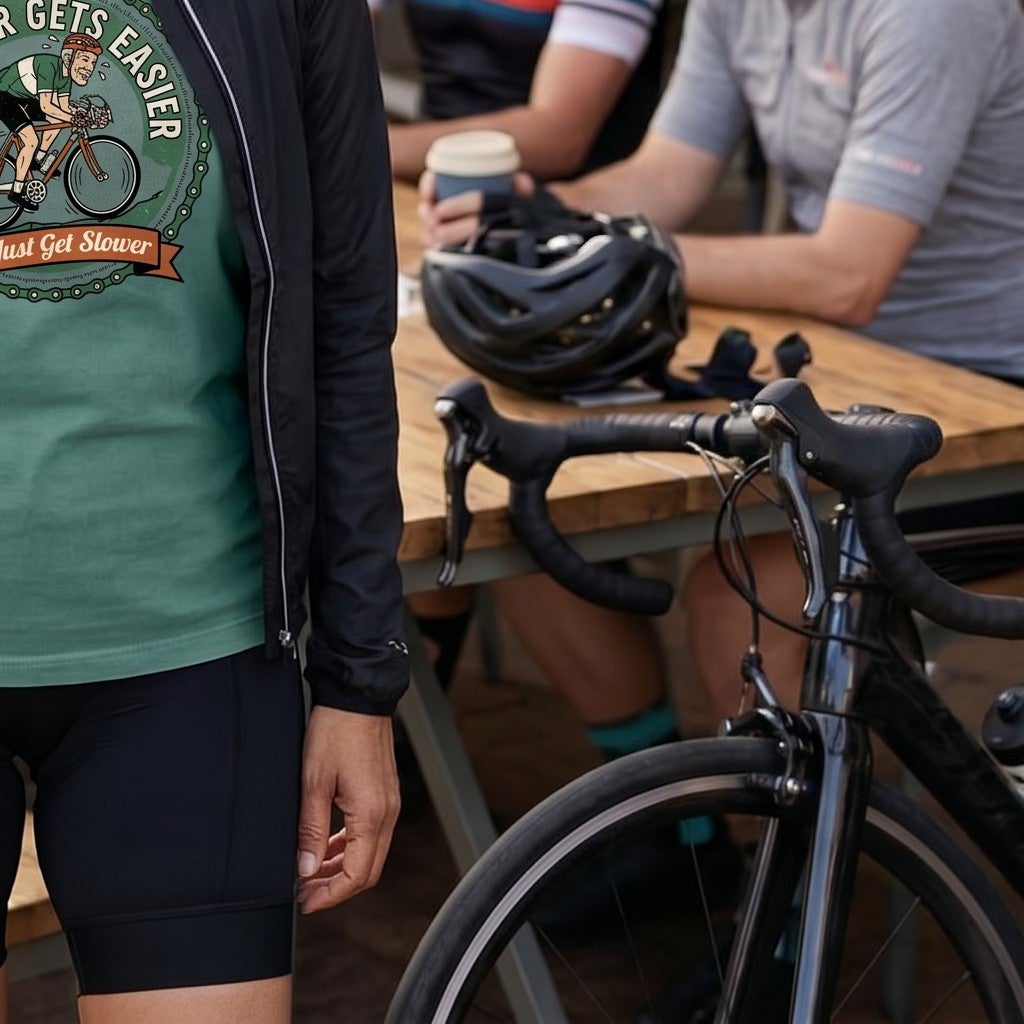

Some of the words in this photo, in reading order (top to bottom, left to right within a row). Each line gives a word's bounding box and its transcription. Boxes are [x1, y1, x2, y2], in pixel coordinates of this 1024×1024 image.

[107, 24, 183, 140] EASIER
[39, 233, 73, 260] Get
[79, 230, 153, 255] Slower
